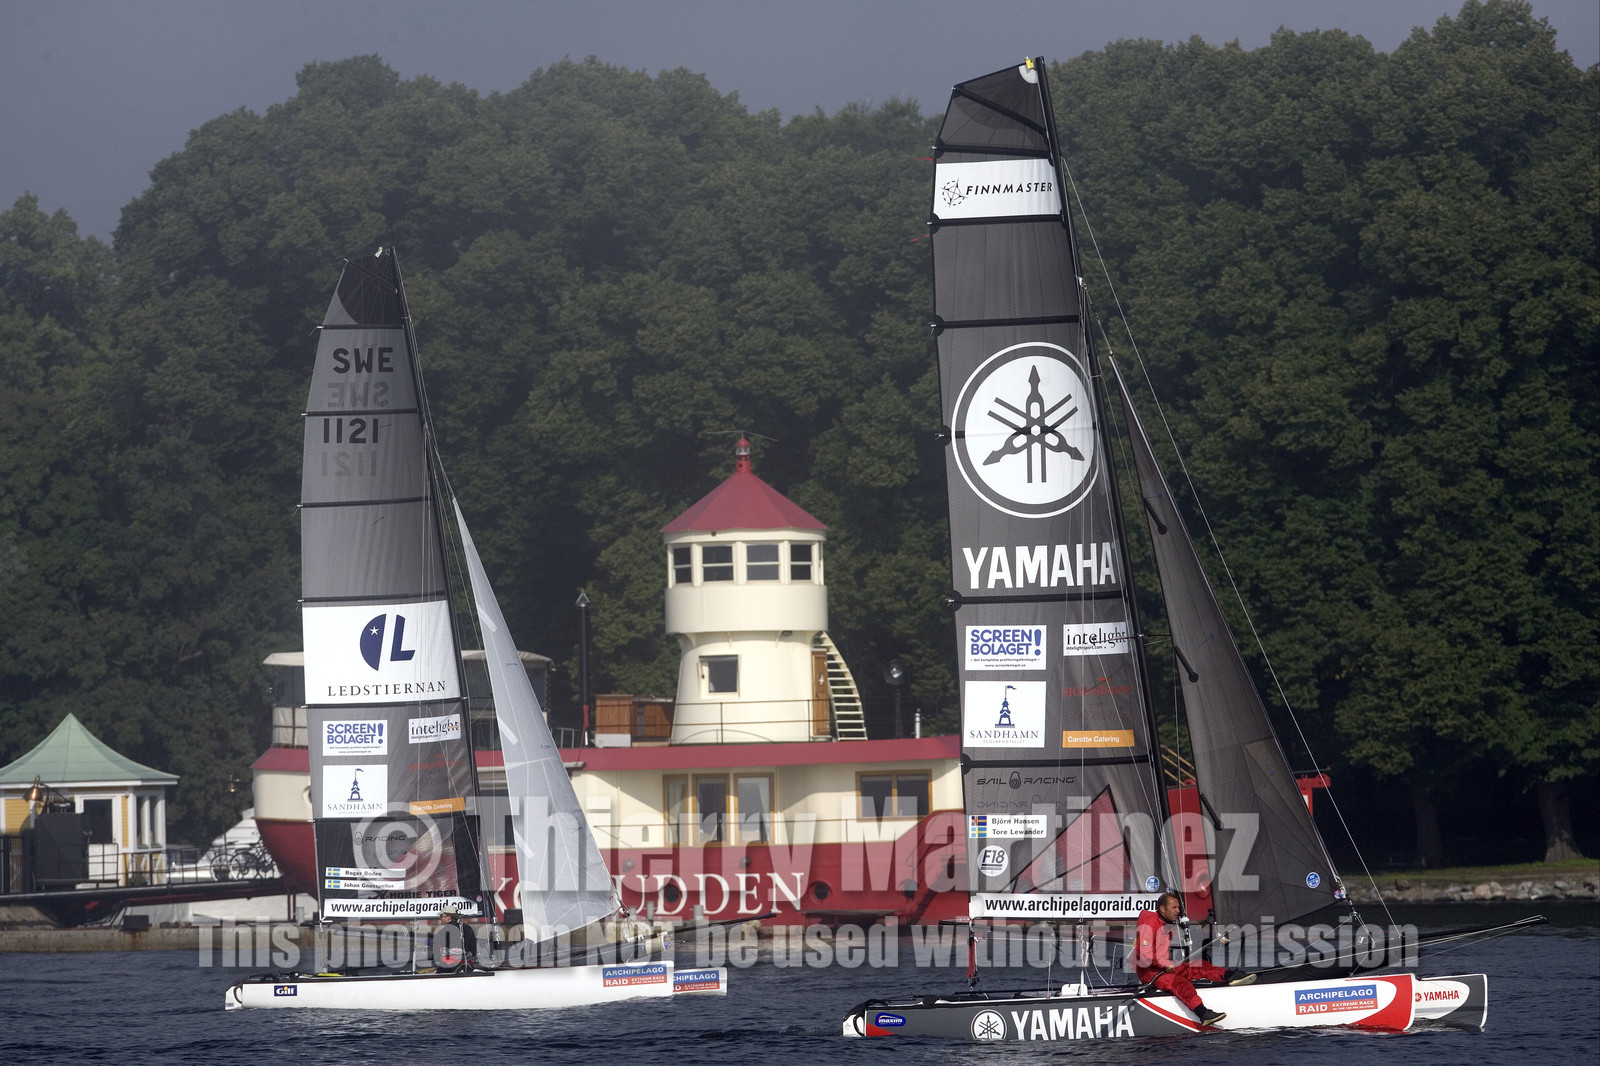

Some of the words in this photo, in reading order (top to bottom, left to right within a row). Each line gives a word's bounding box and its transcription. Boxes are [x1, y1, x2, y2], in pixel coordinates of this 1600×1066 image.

[966, 182, 1053, 196] FINNMASTER
[332, 347, 394, 374] SWE
[323, 418, 379, 444] 1121
[962, 542, 1116, 590] YAMAHA
[1066, 627, 1127, 649] intelight
[970, 643, 1032, 656] BOLAGET
[328, 680, 447, 697] LEDSTIERNAN
[411, 719, 459, 736] intelight
[326, 734, 376, 744] BOLAGET
[969, 730, 1039, 739] SANDHAMN
[1067, 735, 1093, 743] Carotte
[1093, 735, 1120, 743] Catering
[1023, 776, 1075, 785] RACING
[327, 803, 383, 811] SANDHAMN
[991, 817, 1011, 826] Björn
[982, 849, 1005, 864] F18
[389, 891, 422, 899] HOBIE
[426, 890, 457, 898] TIGER
[331, 899, 472, 915] www.archipelagoraidom
[984, 896, 1158, 915] www.archipelagoraid.com
[605, 967, 664, 977] ARCHIPELAGO
[673, 973, 717, 981] HIPELAGO
[276, 986, 295, 995] Gill
[1298, 988, 1374, 1001] ARCHIPELAGO
[1423, 990, 1460, 1001] YAMAHA
[1299, 1004, 1328, 1014] RAID
[1010, 1005, 1135, 1040] YAMAHA
